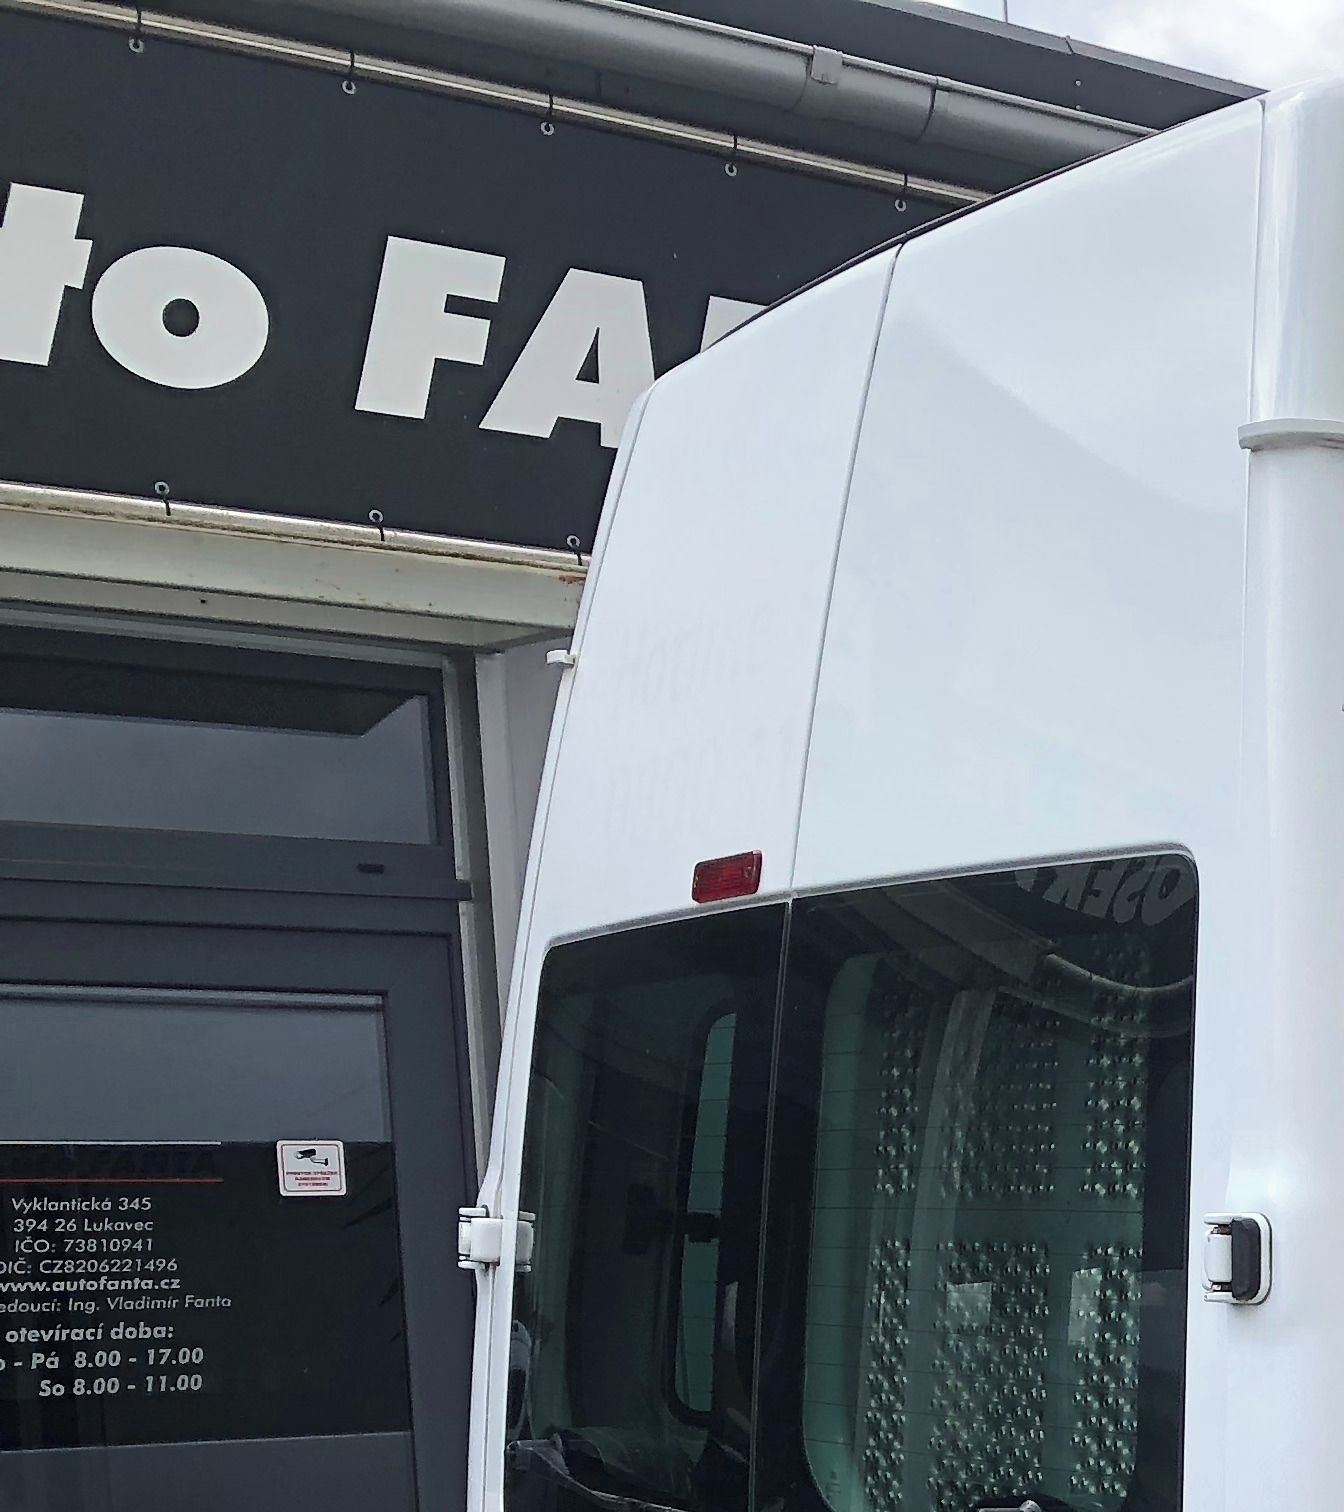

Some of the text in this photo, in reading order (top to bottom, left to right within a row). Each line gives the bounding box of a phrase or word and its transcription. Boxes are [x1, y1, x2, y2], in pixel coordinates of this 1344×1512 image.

[355, 236, 770, 448] FA
[12, 1197, 151, 1214] Vyklantická 345
[13, 1218, 154, 1232] 394 26 Lukavec
[15, 1236, 153, 1253] IČO: 73810941
[39, 1258, 178, 1274] CZ8206221496
[69, 1298, 100, 1314] Ing.
[107, 1296, 179, 1310] Vladimír
[184, 1295, 232, 1308] Fanta
[5, 1321, 174, 1343] otevírací doba:
[30, 1351, 60, 1369] Pá
[74, 1350, 121, 1368] 8.00
[147, 1347, 204, 1365] 17.00
[38, 1379, 65, 1397] So
[72, 1377, 120, 1396] 8.00
[146, 1374, 203, 1392] 11.00
